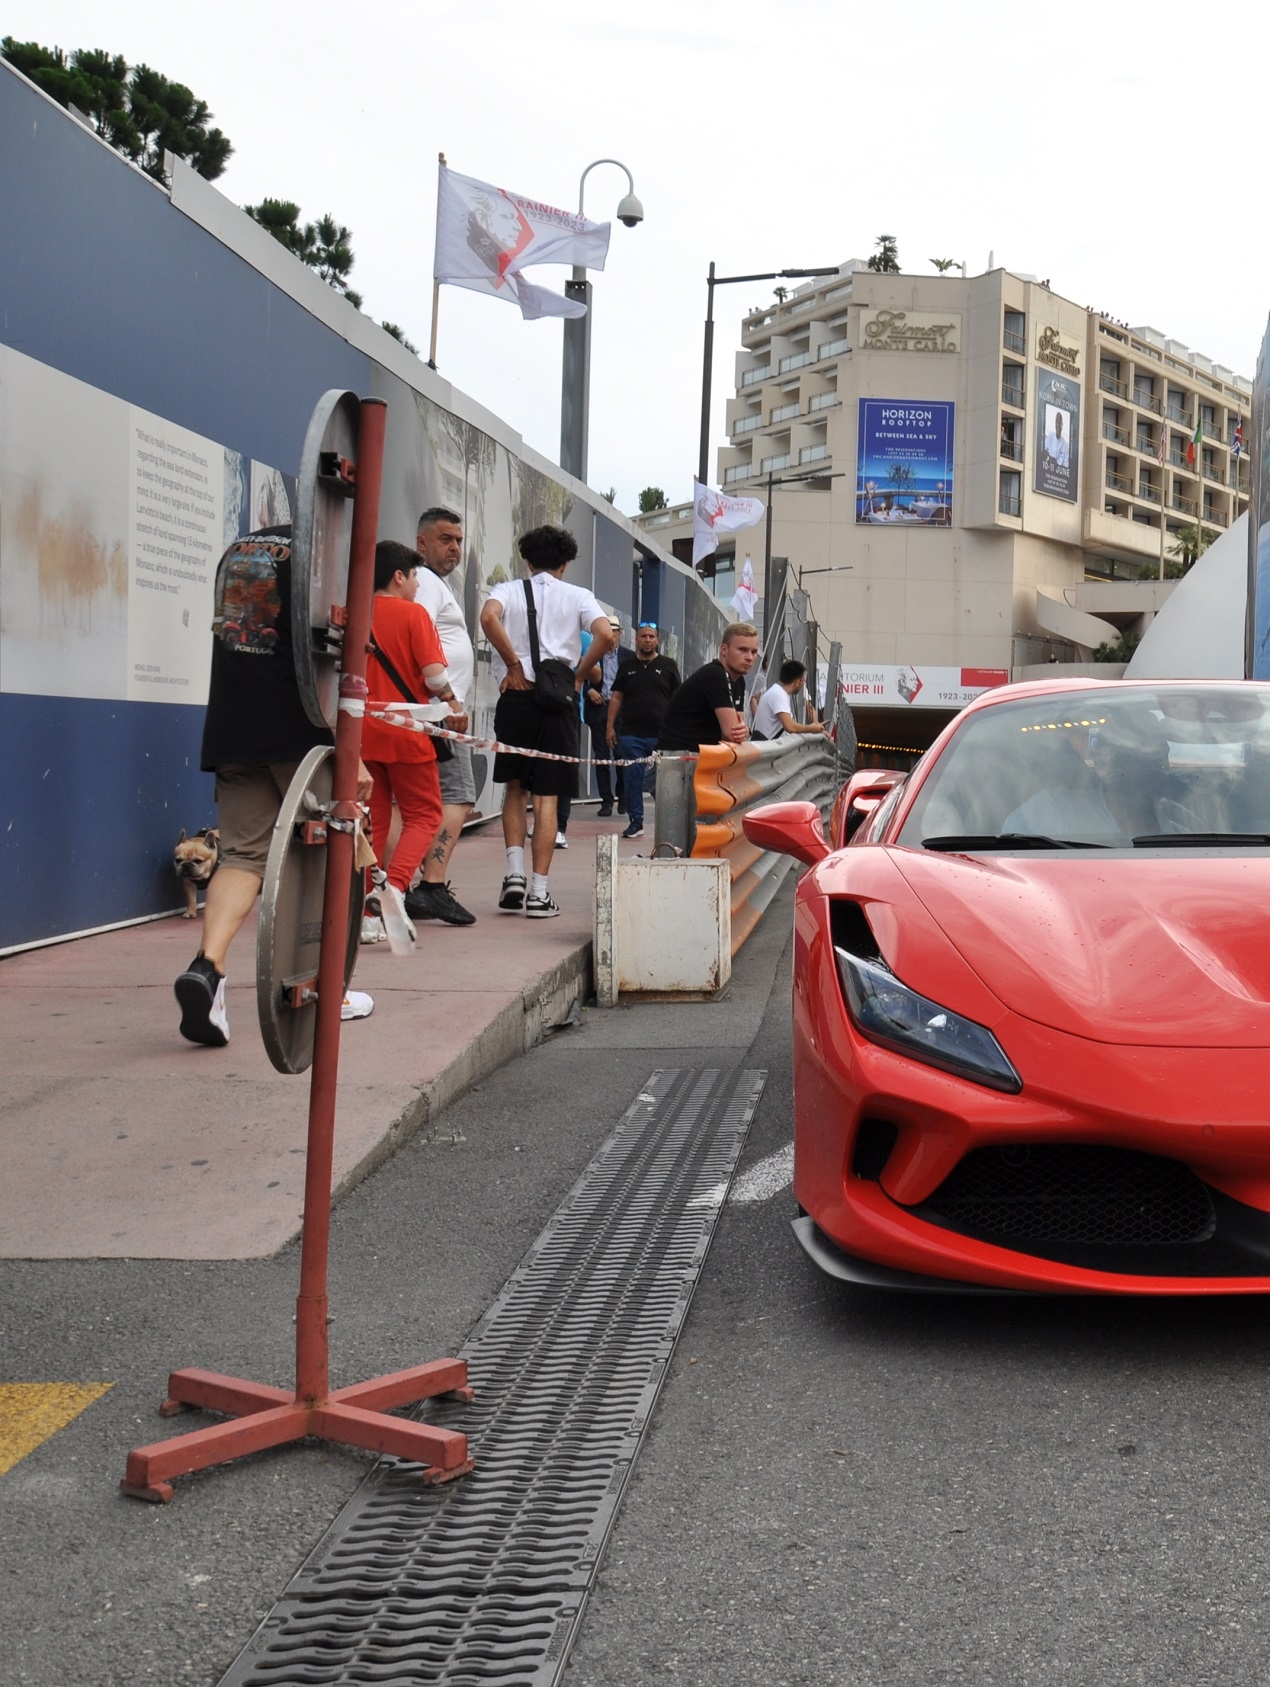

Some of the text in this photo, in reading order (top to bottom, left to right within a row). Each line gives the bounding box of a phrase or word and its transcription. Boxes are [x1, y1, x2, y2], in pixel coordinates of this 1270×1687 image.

[524, 209, 586, 232] 1923-2023
[865, 310, 955, 338] Fairmont
[863, 338, 957, 352] MONTE CARLO
[882, 409, 932, 420] HORIZON
[881, 419, 932, 427] ROOFTOP
[1055, 465, 1071, 478] JUNE
[873, 685, 884, 695] III
